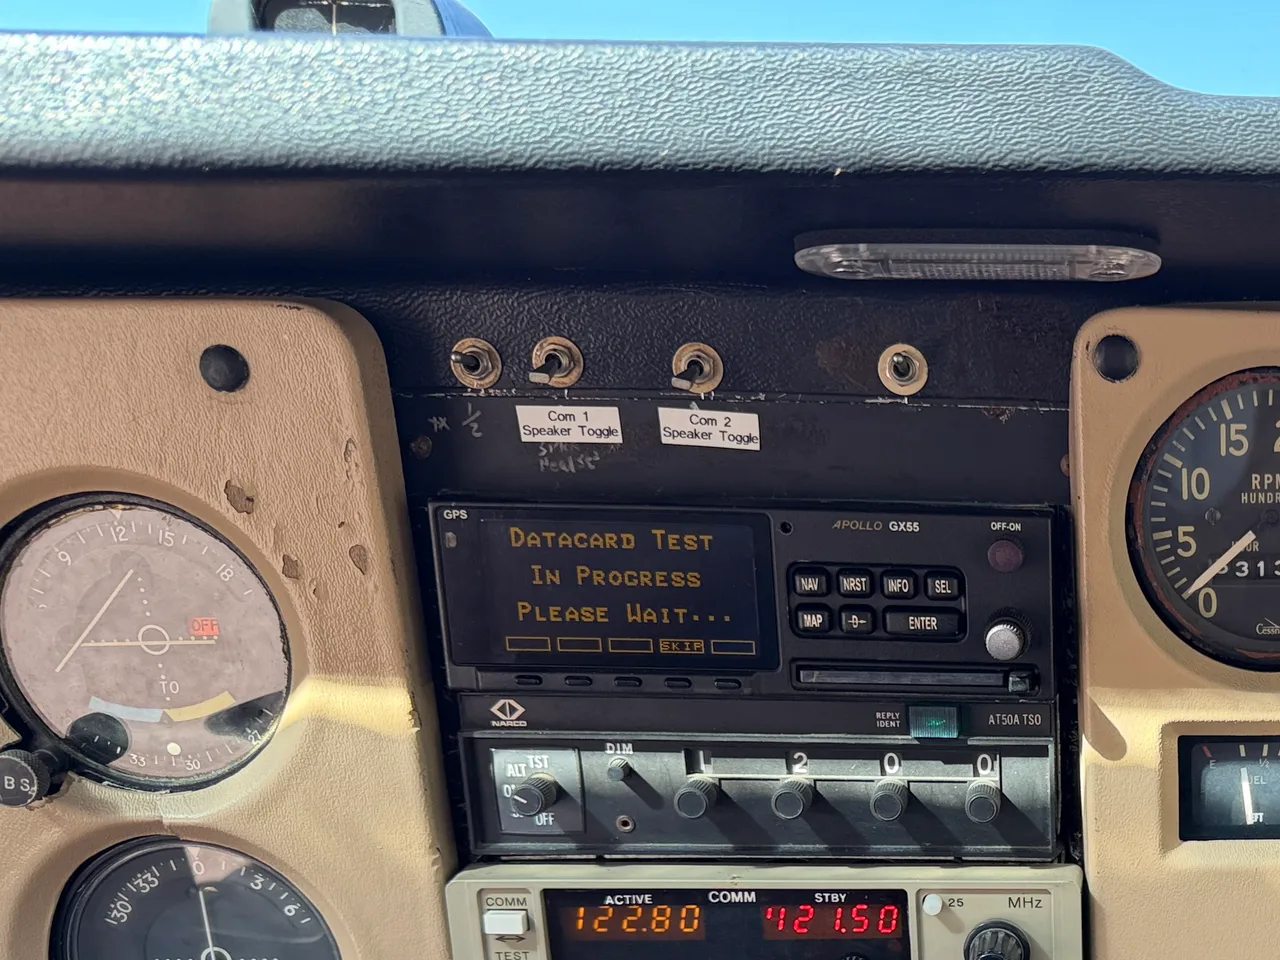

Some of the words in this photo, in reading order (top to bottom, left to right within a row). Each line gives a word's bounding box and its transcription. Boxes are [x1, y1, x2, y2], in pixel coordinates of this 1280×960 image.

[548, 411, 576, 422] Com
[583, 411, 589, 422] 1
[689, 415, 717, 427] Com
[724, 416, 732, 428] 2
[522, 425, 572, 437] Speaker
[578, 425, 619, 439] Toggle
[663, 427, 713, 442] Speaker
[721, 429, 759, 446] Toggle
[1181, 467, 1211, 500] 10
[444, 509, 468, 519] GPS
[832, 520, 883, 531] APOLLO
[889, 521, 920, 532] GX55
[990, 521, 1021, 532] OFF-ON
[110, 525, 129, 542] 12
[157, 529, 176, 547] 15
[652, 529, 713, 551] TEST
[801, 578, 819, 591] NAV
[843, 578, 866, 591] NRST
[888, 579, 909, 592] INFO
[934, 580, 951, 593] SEL
[191, 619, 218, 634] OFF
[803, 614, 823, 628] MAP
[908, 616, 938, 630] ENTER
[660, 640, 704, 654] SKIP
[159, 680, 180, 694] TO
[876, 711, 900, 720] REPLY
[988, 714, 1019, 726] AT50A
[1023, 714, 1042, 726] TSO
[876, 720, 901, 728] IDENT
[605, 743, 633, 754] DIM
[129, 753, 147, 767] 33
[186, 757, 201, 771] 30
[526, 755, 549, 768] TST
[506, 763, 527, 777] ALT
[535, 812, 555, 826] OFF
[133, 874, 160, 894] 33
[485, 897, 527, 907] COMM
[605, 894, 653, 905] ACTIVE
[708, 891, 756, 903] COMM
[814, 892, 847, 903] STBY
[948, 898, 964, 908] 25
[1008, 897, 1043, 909] MHz
[111, 900, 134, 924] 30
[576, 905, 700, 933] 122.80
[495, 951, 530, 960] TEST
